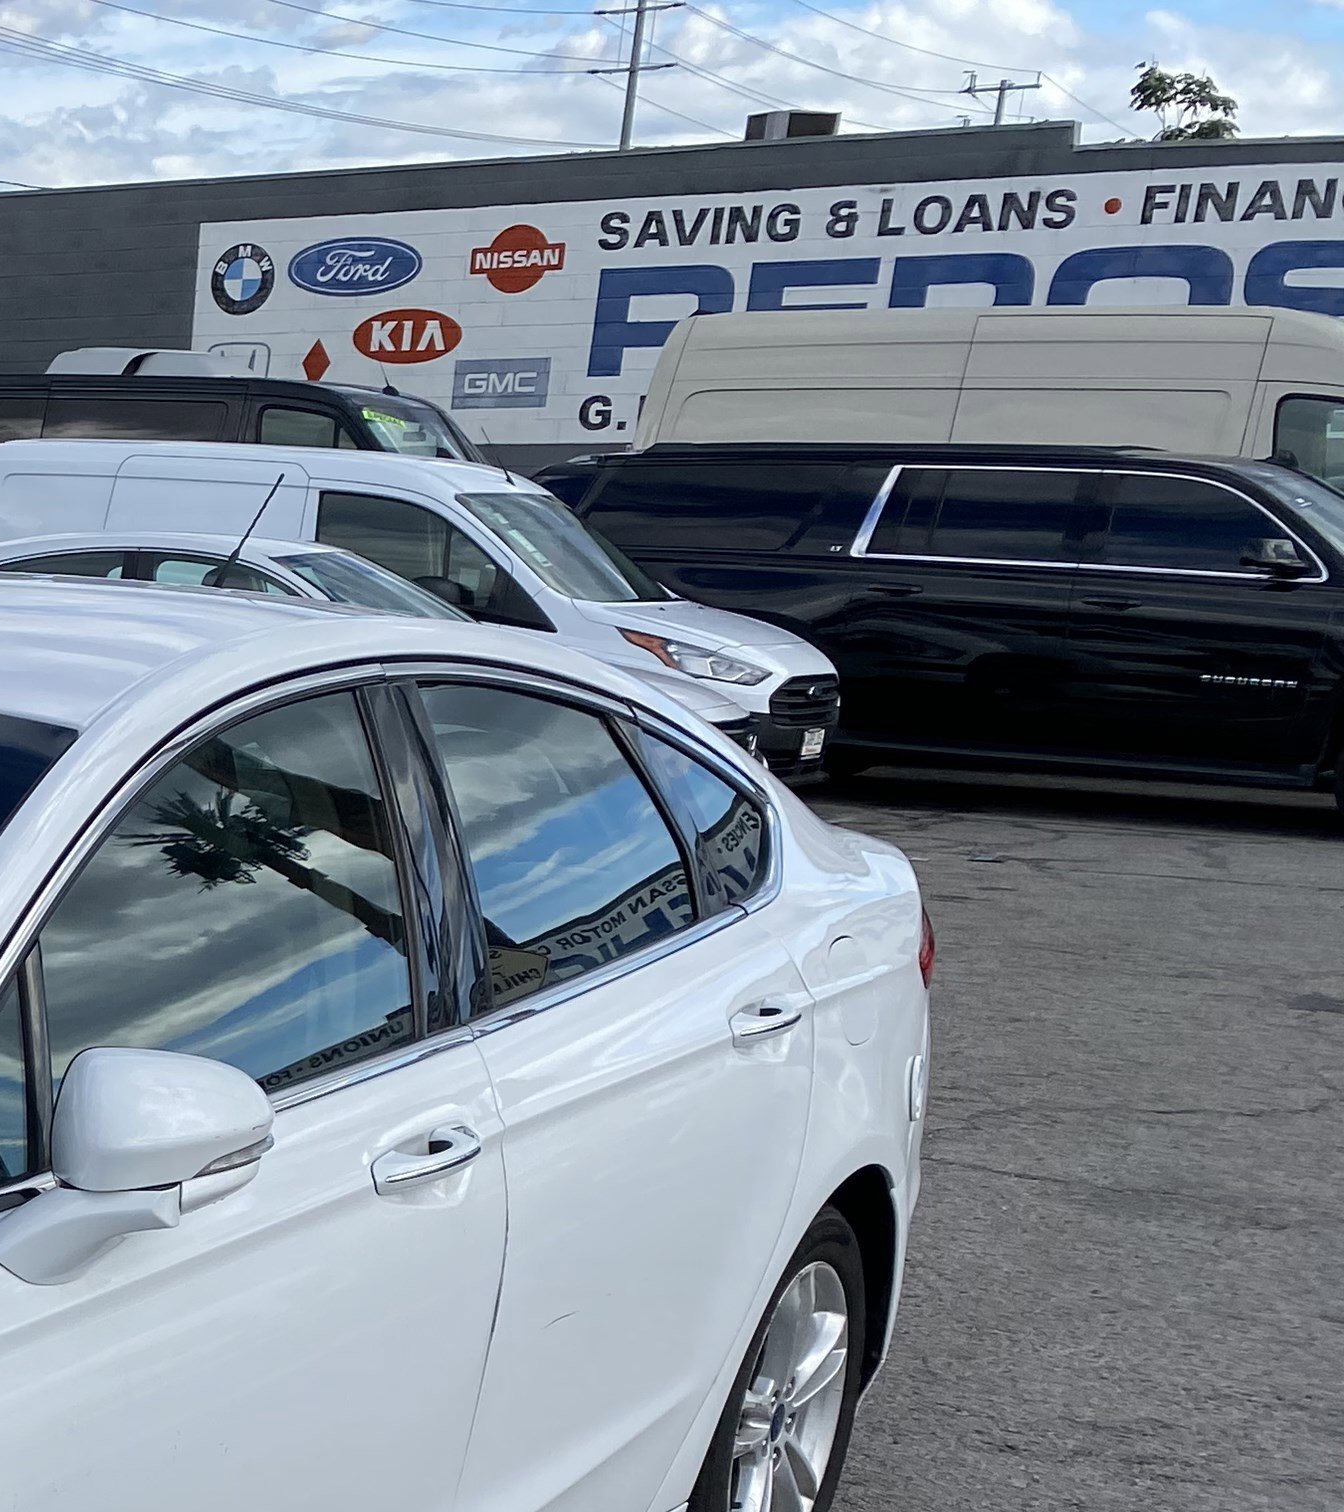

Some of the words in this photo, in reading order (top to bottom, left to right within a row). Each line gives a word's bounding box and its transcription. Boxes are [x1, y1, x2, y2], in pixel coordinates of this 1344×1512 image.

[598, 203, 801, 250] SAVING
[826, 200, 859, 238] &
[876, 189, 1078, 236] LOANS
[1140, 178, 1344, 224] FINAN
[316, 249, 393, 284] Ford
[475, 248, 561, 270] NISSAN
[369, 320, 448, 352] KIA
[463, 371, 538, 394] GMC
